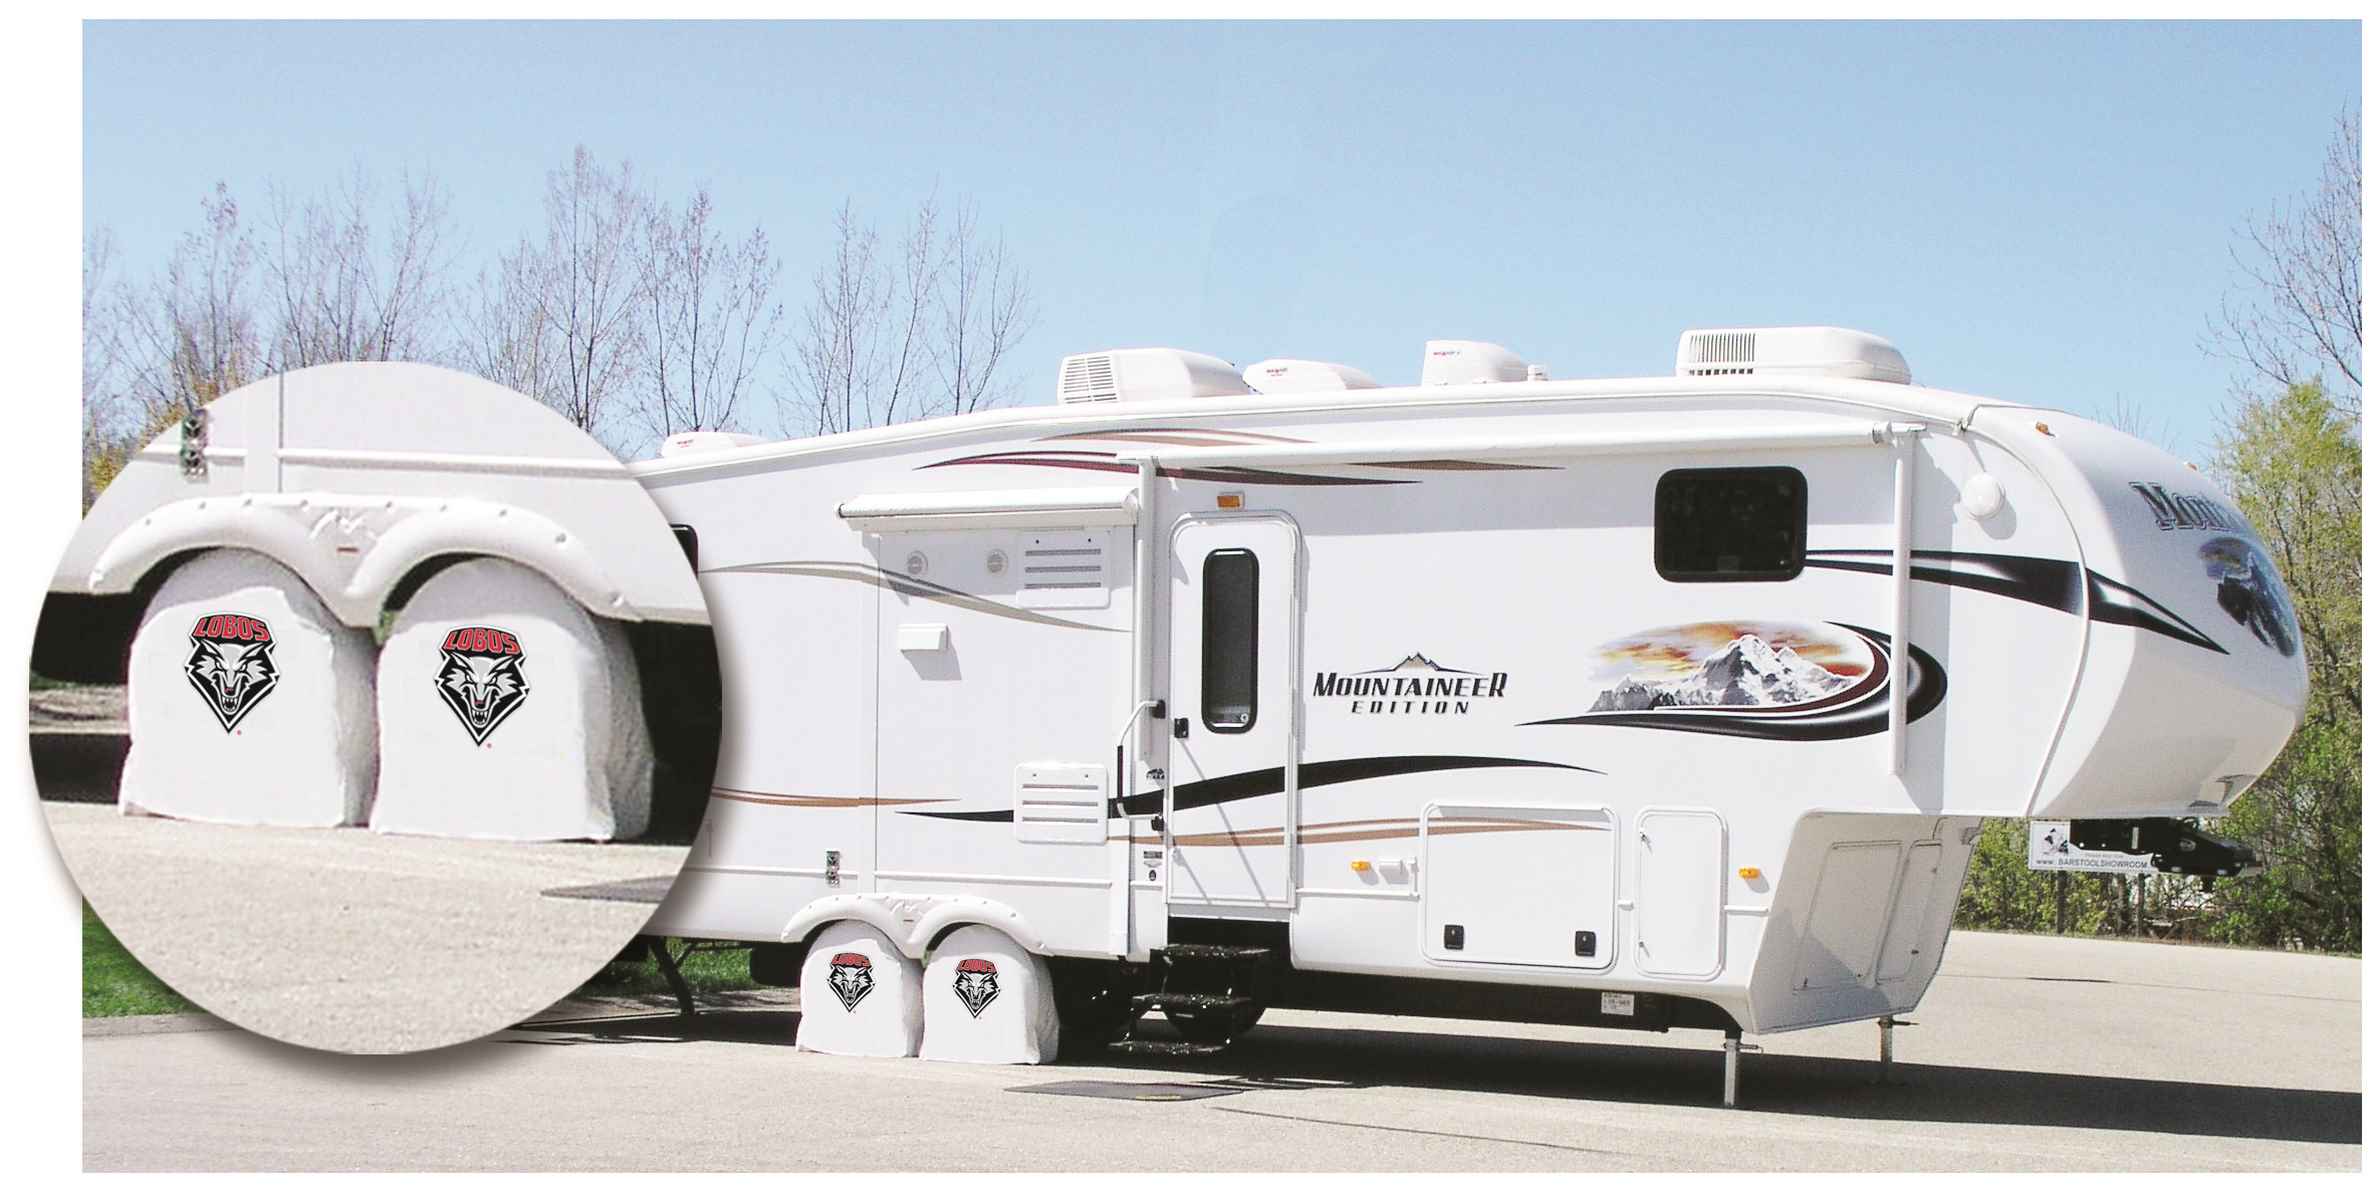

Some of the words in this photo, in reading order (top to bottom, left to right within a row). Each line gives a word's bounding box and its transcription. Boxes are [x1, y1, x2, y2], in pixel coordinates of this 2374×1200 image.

[193, 614, 270, 642] LOBOS
[444, 627, 520, 655] LOBOS
[1313, 672, 1508, 697] MOUNTAINEER
[1351, 700, 1470, 714] EDITION
